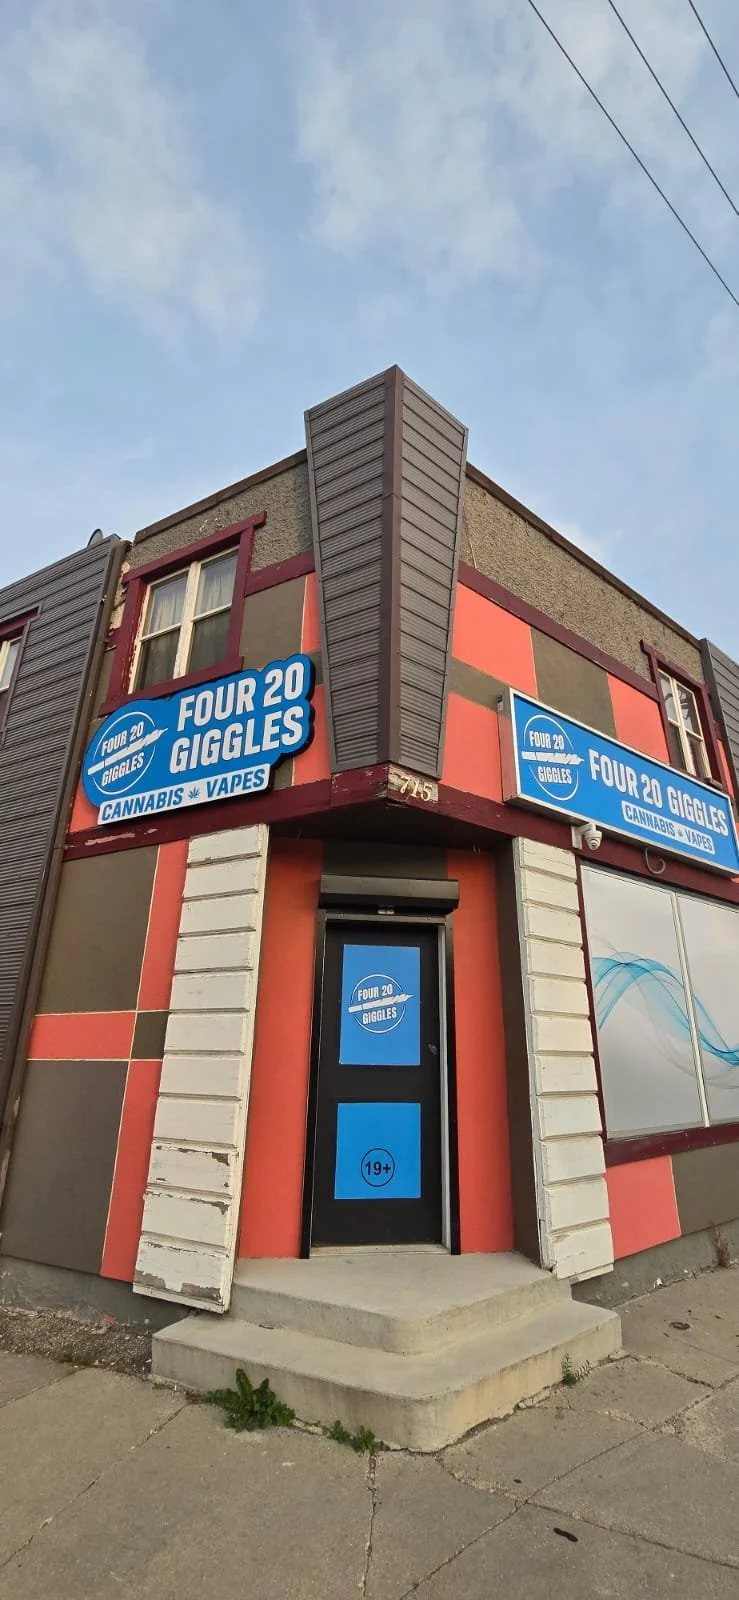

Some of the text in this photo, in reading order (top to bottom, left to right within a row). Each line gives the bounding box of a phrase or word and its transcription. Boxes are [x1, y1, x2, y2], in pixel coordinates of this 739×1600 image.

[177, 661, 304, 732] FOUR 20
[101, 721, 145, 756] FOUR 20
[169, 705, 304, 775] GIGGLES
[529, 730, 565, 750] FOUR 20
[101, 751, 145, 787] GIGGLES
[537, 766, 572, 785] GIGGLES
[101, 768, 265, 821] CANNABIS VAPES
[400, 775, 433, 801] 715
[588, 748, 729, 837] FOUR 20 GIGGLES
[624, 804, 713, 852] CANNABIS VAPES
[357, 983, 393, 1001] FOUR 20
[362, 1006, 397, 1025] GIGGLES
[364, 1161, 391, 1176] 19+
